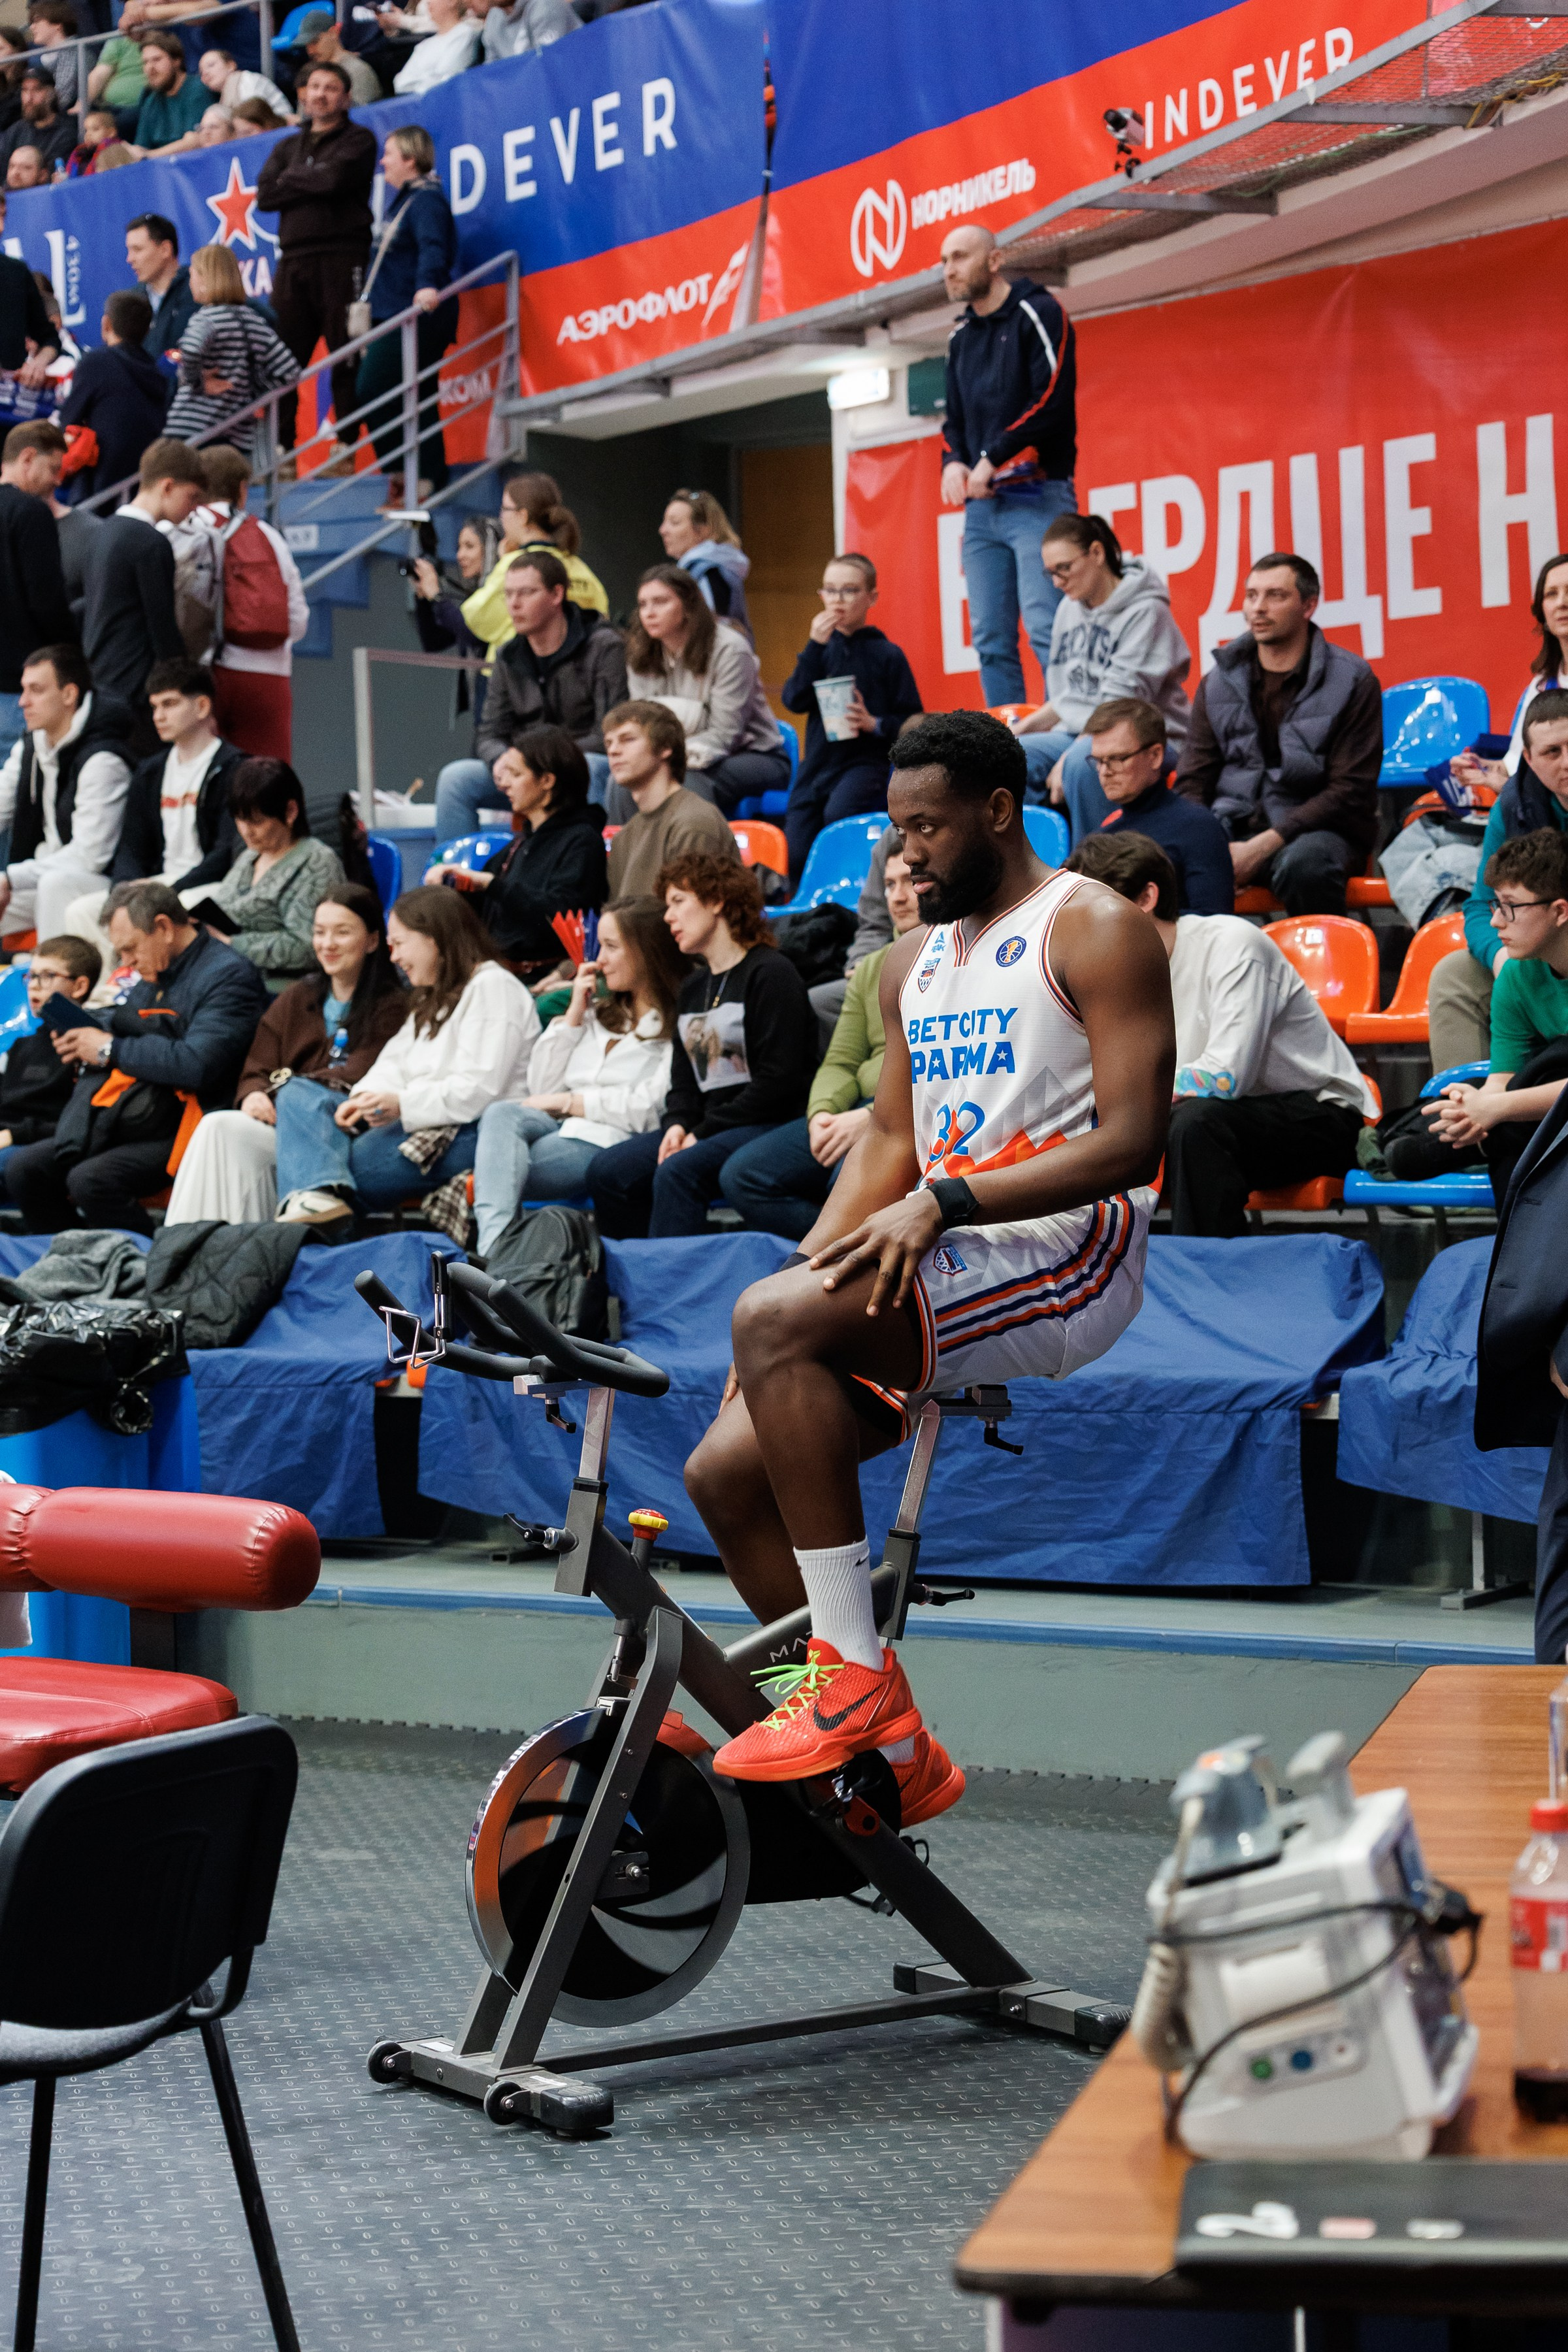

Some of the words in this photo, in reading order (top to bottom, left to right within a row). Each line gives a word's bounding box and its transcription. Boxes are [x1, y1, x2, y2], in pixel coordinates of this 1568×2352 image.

[1145, 27, 1354, 150] INDEVER
[372, 77, 678, 234] IDEVER
[911, 157, 1036, 230] НОРНИКЕЛЬ
[556, 272, 713, 346] АЭРОФЛОТ
[908, 1007, 1019, 1045] BETCITY
[911, 1041, 1015, 1084] PARMA
[929, 1101, 985, 1162] 32
